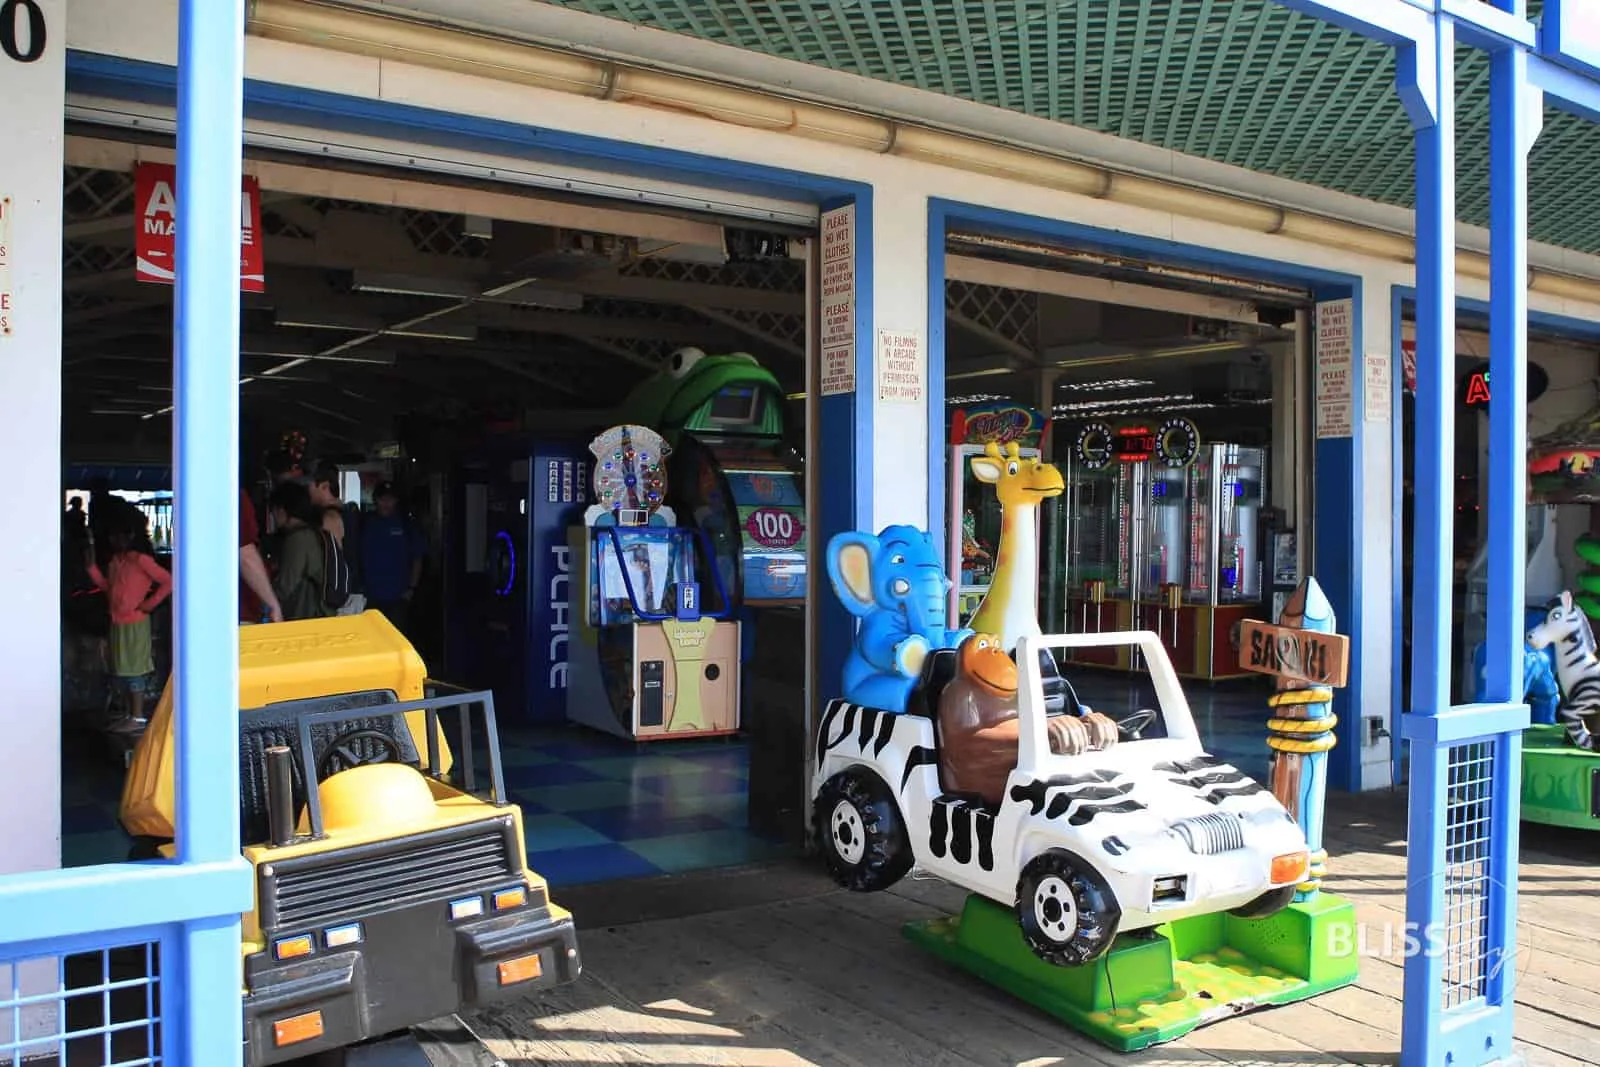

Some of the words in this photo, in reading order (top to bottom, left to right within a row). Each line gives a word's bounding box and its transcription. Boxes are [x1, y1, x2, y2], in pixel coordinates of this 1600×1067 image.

[826, 213, 848, 231] PLEASE
[826, 233, 834, 244] NO
[836, 229, 849, 241] WET
[825, 243, 850, 259] CLOTHES
[826, 303, 849, 317] PLEASE
[883, 335, 892, 346] NO
[894, 336, 917, 348] FILMING
[893, 348, 916, 360] ARCADE
[887, 360, 914, 371] WITHOUT
[883, 372, 919, 385] PERMISSION
[880, 385, 898, 397] FROM
[755, 511, 792, 538] 100
